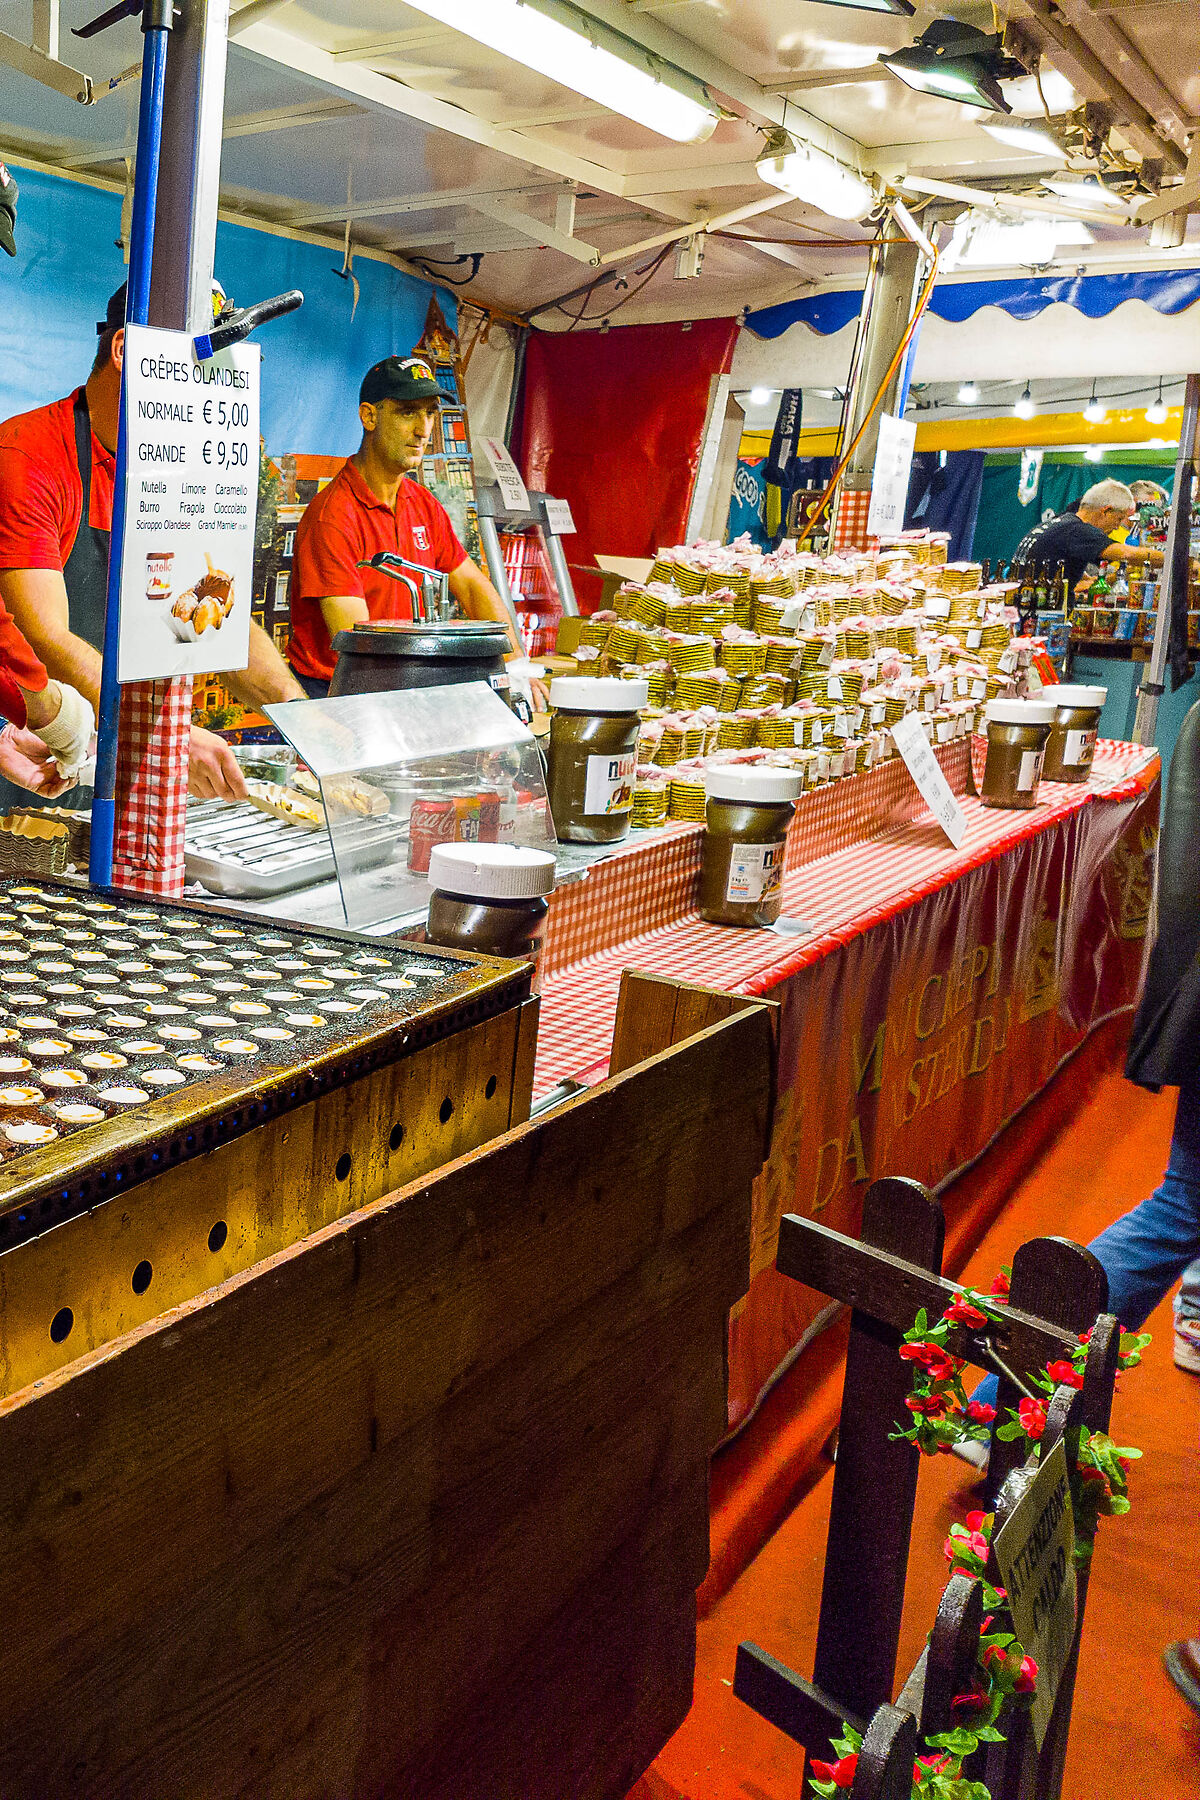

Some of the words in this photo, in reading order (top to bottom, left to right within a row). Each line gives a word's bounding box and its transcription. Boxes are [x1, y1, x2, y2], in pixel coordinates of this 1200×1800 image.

[140, 353, 189, 382] CRÊPES
[192, 364, 249, 390] OLANDESI
[138, 400, 194, 423] NORMALE
[202, 399, 212, 424] €
[217, 400, 249, 431] 5,00
[138, 443, 186, 463] GRANDE
[202, 440, 212, 464] €
[217, 441, 248, 470] 9,50
[141, 481, 167, 494] Nutella
[181, 482, 207, 495] Limone
[215, 483, 248, 496] Caramello
[139, 500, 160, 513] Burro
[179, 501, 205, 516] Fragola
[213, 502, 247, 515] Cioccolato
[136, 519, 162, 532] Sciroppo
[163, 519, 191, 530] Olandese
[197, 520, 215, 530] Grand
